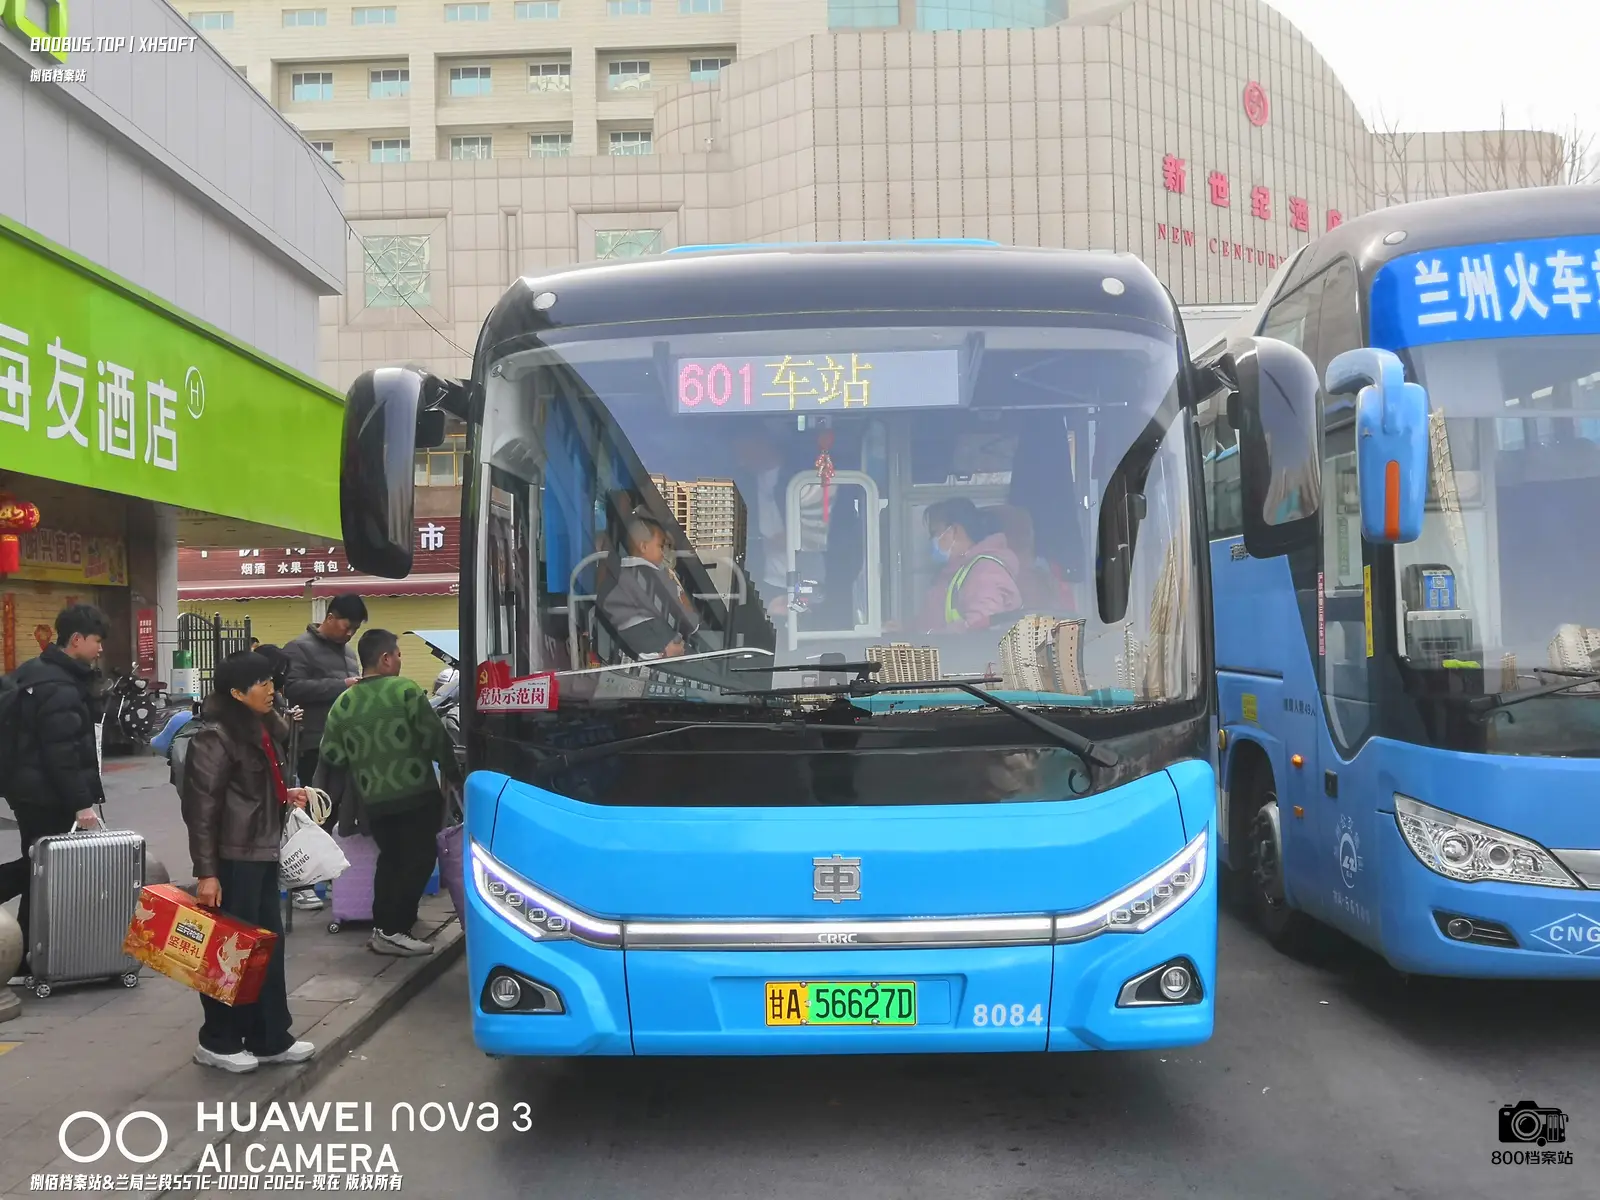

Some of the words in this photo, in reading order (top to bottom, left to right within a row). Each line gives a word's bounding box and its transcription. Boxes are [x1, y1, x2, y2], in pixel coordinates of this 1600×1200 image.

[1157, 223, 1195, 247] NEW
[1415, 249, 1600, 325] 兰州火车
[679, 363, 752, 406] 601
[762, 353, 872, 410] 车站
[241, 563, 266, 575] 烟酒
[277, 561, 302, 574] 水果
[313, 560, 339, 573] 箱包
[480, 687, 545, 706] 党员示范岗
[283, 848, 304, 867] HAPPY
[290, 853, 310, 871] THING
[817, 933, 858, 944] CRRC
[1549, 925, 1600, 942] CNG
[167, 935, 201, 959] 坚果礼
[769, 988, 802, 1019] 甘A
[815, 988, 912, 1019] 56627D
[972, 1004, 1043, 1027] 8084
